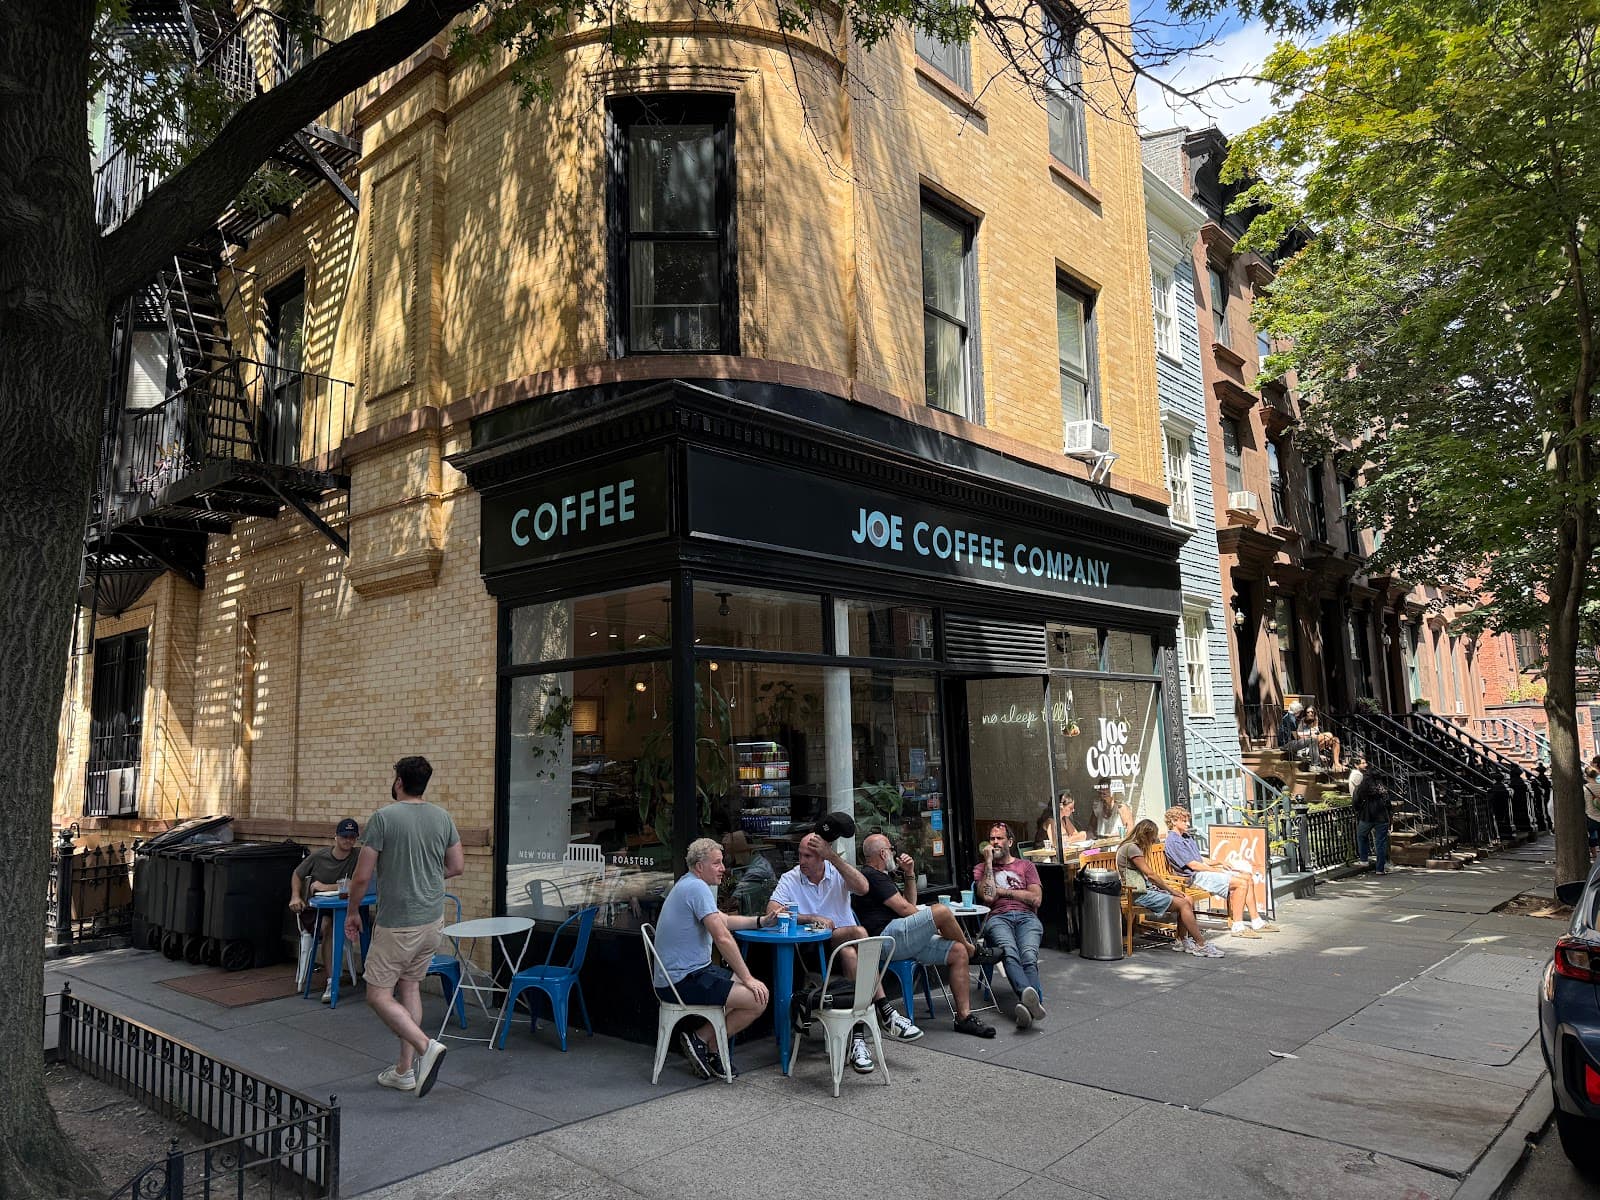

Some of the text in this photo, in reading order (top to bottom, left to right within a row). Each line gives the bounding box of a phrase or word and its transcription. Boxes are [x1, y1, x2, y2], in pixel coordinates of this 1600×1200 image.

[511, 479, 635, 547] COFFEE
[851, 507, 1110, 589] JOE COFFEE COMPANY
[982, 713, 998, 725] no
[1000, 704, 1038, 729] sleep
[1041, 702, 1066, 722] tll
[1097, 717, 1128, 752] Joe
[1086, 744, 1141, 778] Coffee
[518, 849, 655, 866] NEW YORK ROASTERS
